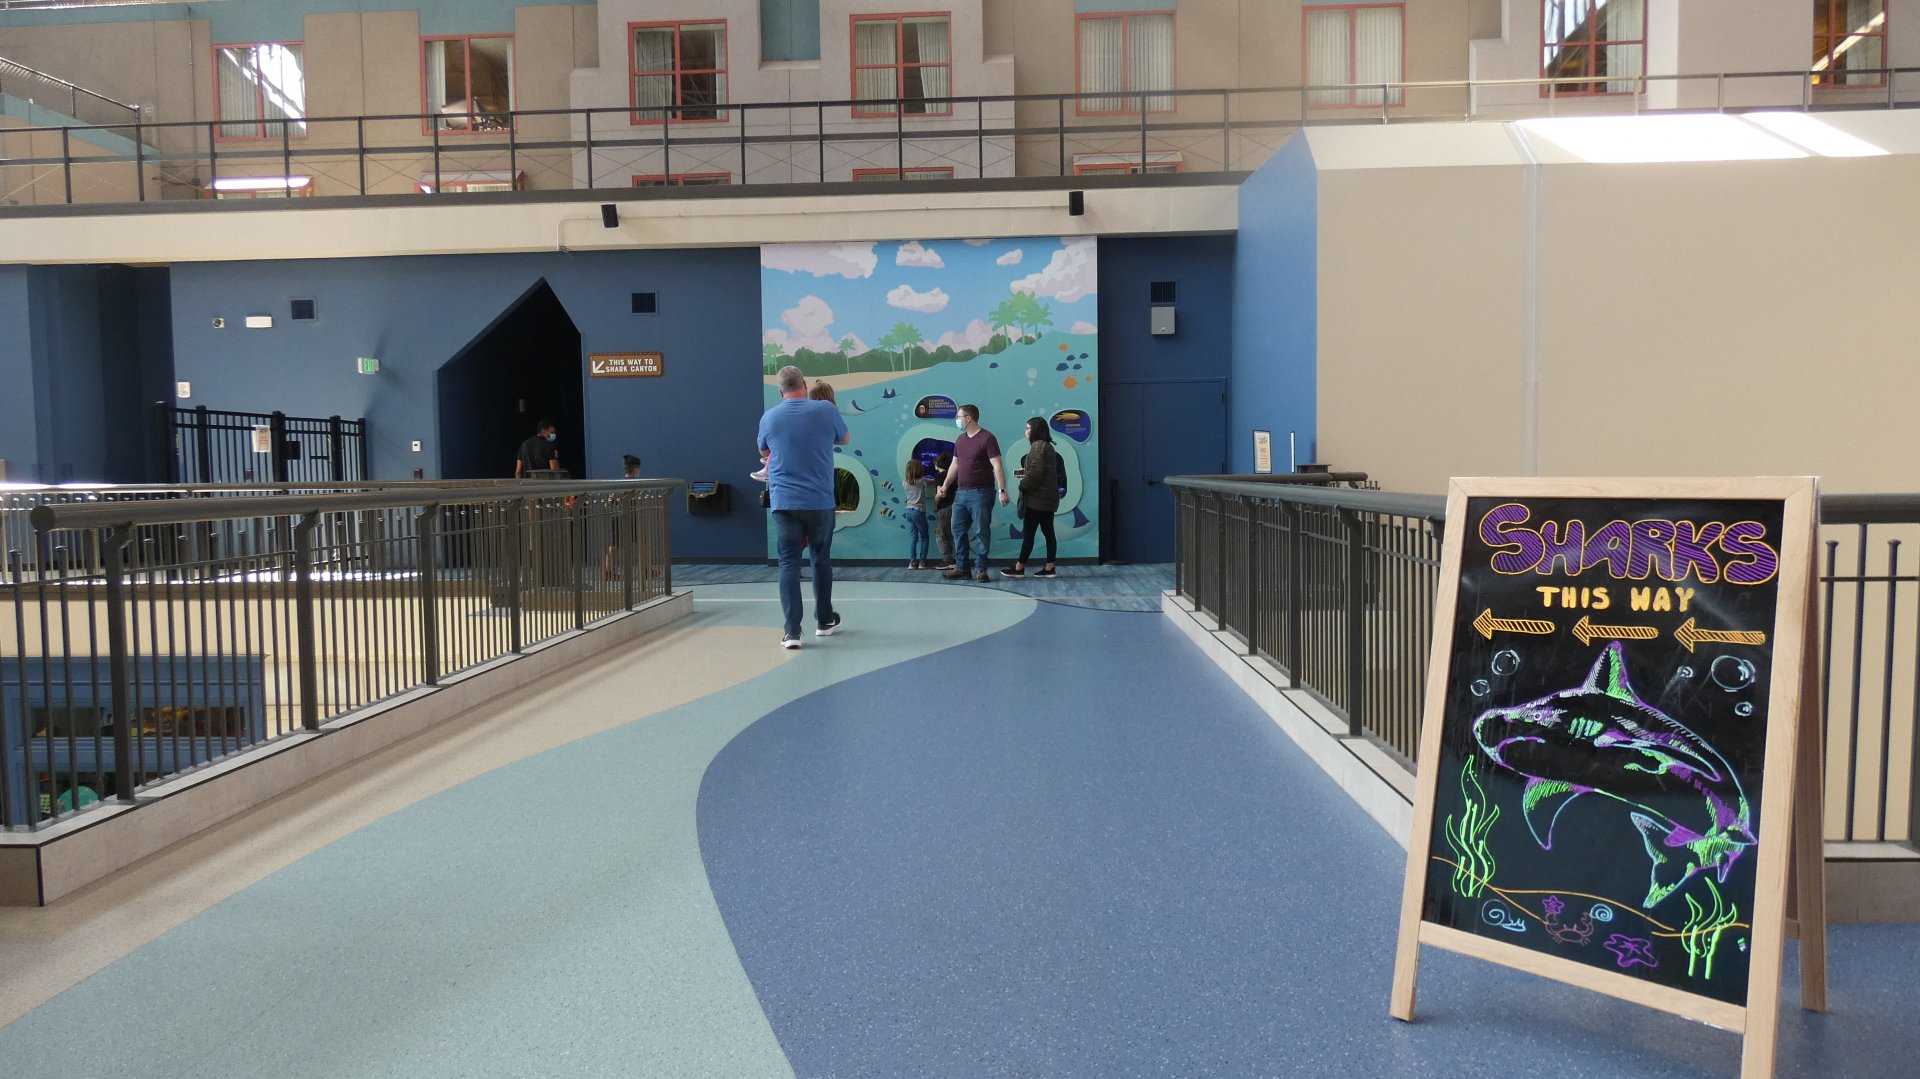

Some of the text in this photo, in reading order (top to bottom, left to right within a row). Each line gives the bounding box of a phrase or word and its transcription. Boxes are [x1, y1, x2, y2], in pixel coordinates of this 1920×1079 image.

[1479, 503, 1779, 585] SHARKS
[1536, 586, 1695, 612] THIS WAY
